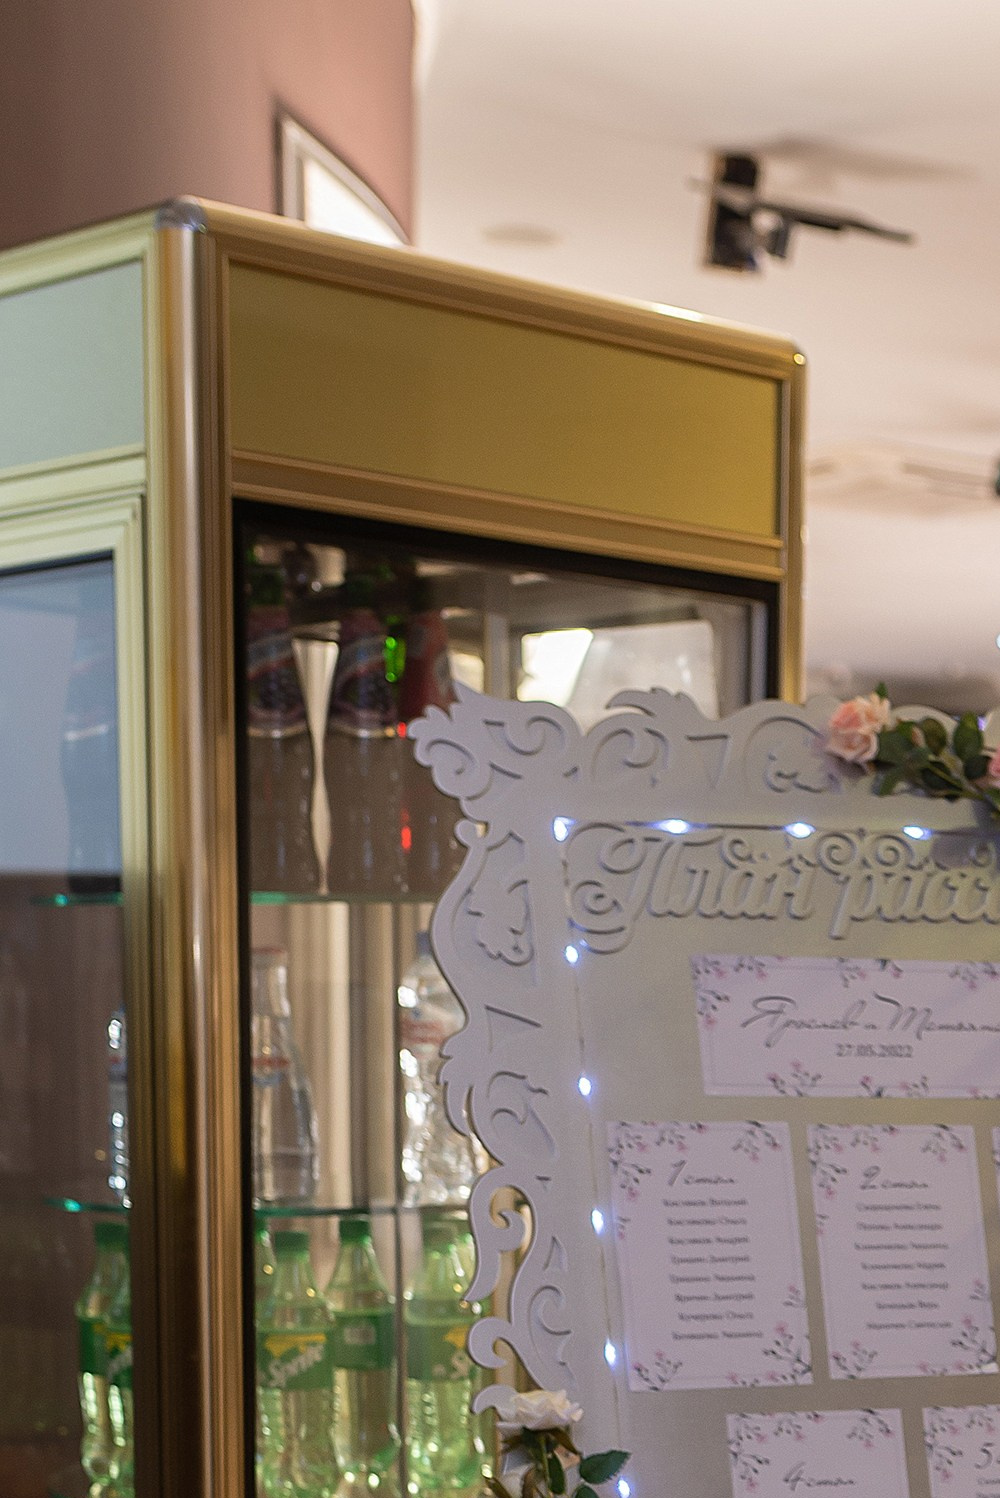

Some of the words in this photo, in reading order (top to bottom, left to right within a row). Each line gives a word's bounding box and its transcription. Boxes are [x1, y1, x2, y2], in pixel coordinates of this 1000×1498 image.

[860, 1165, 880, 1190] 2
[973, 1441, 994, 1471] 5
[783, 1460, 807, 1493] 4
